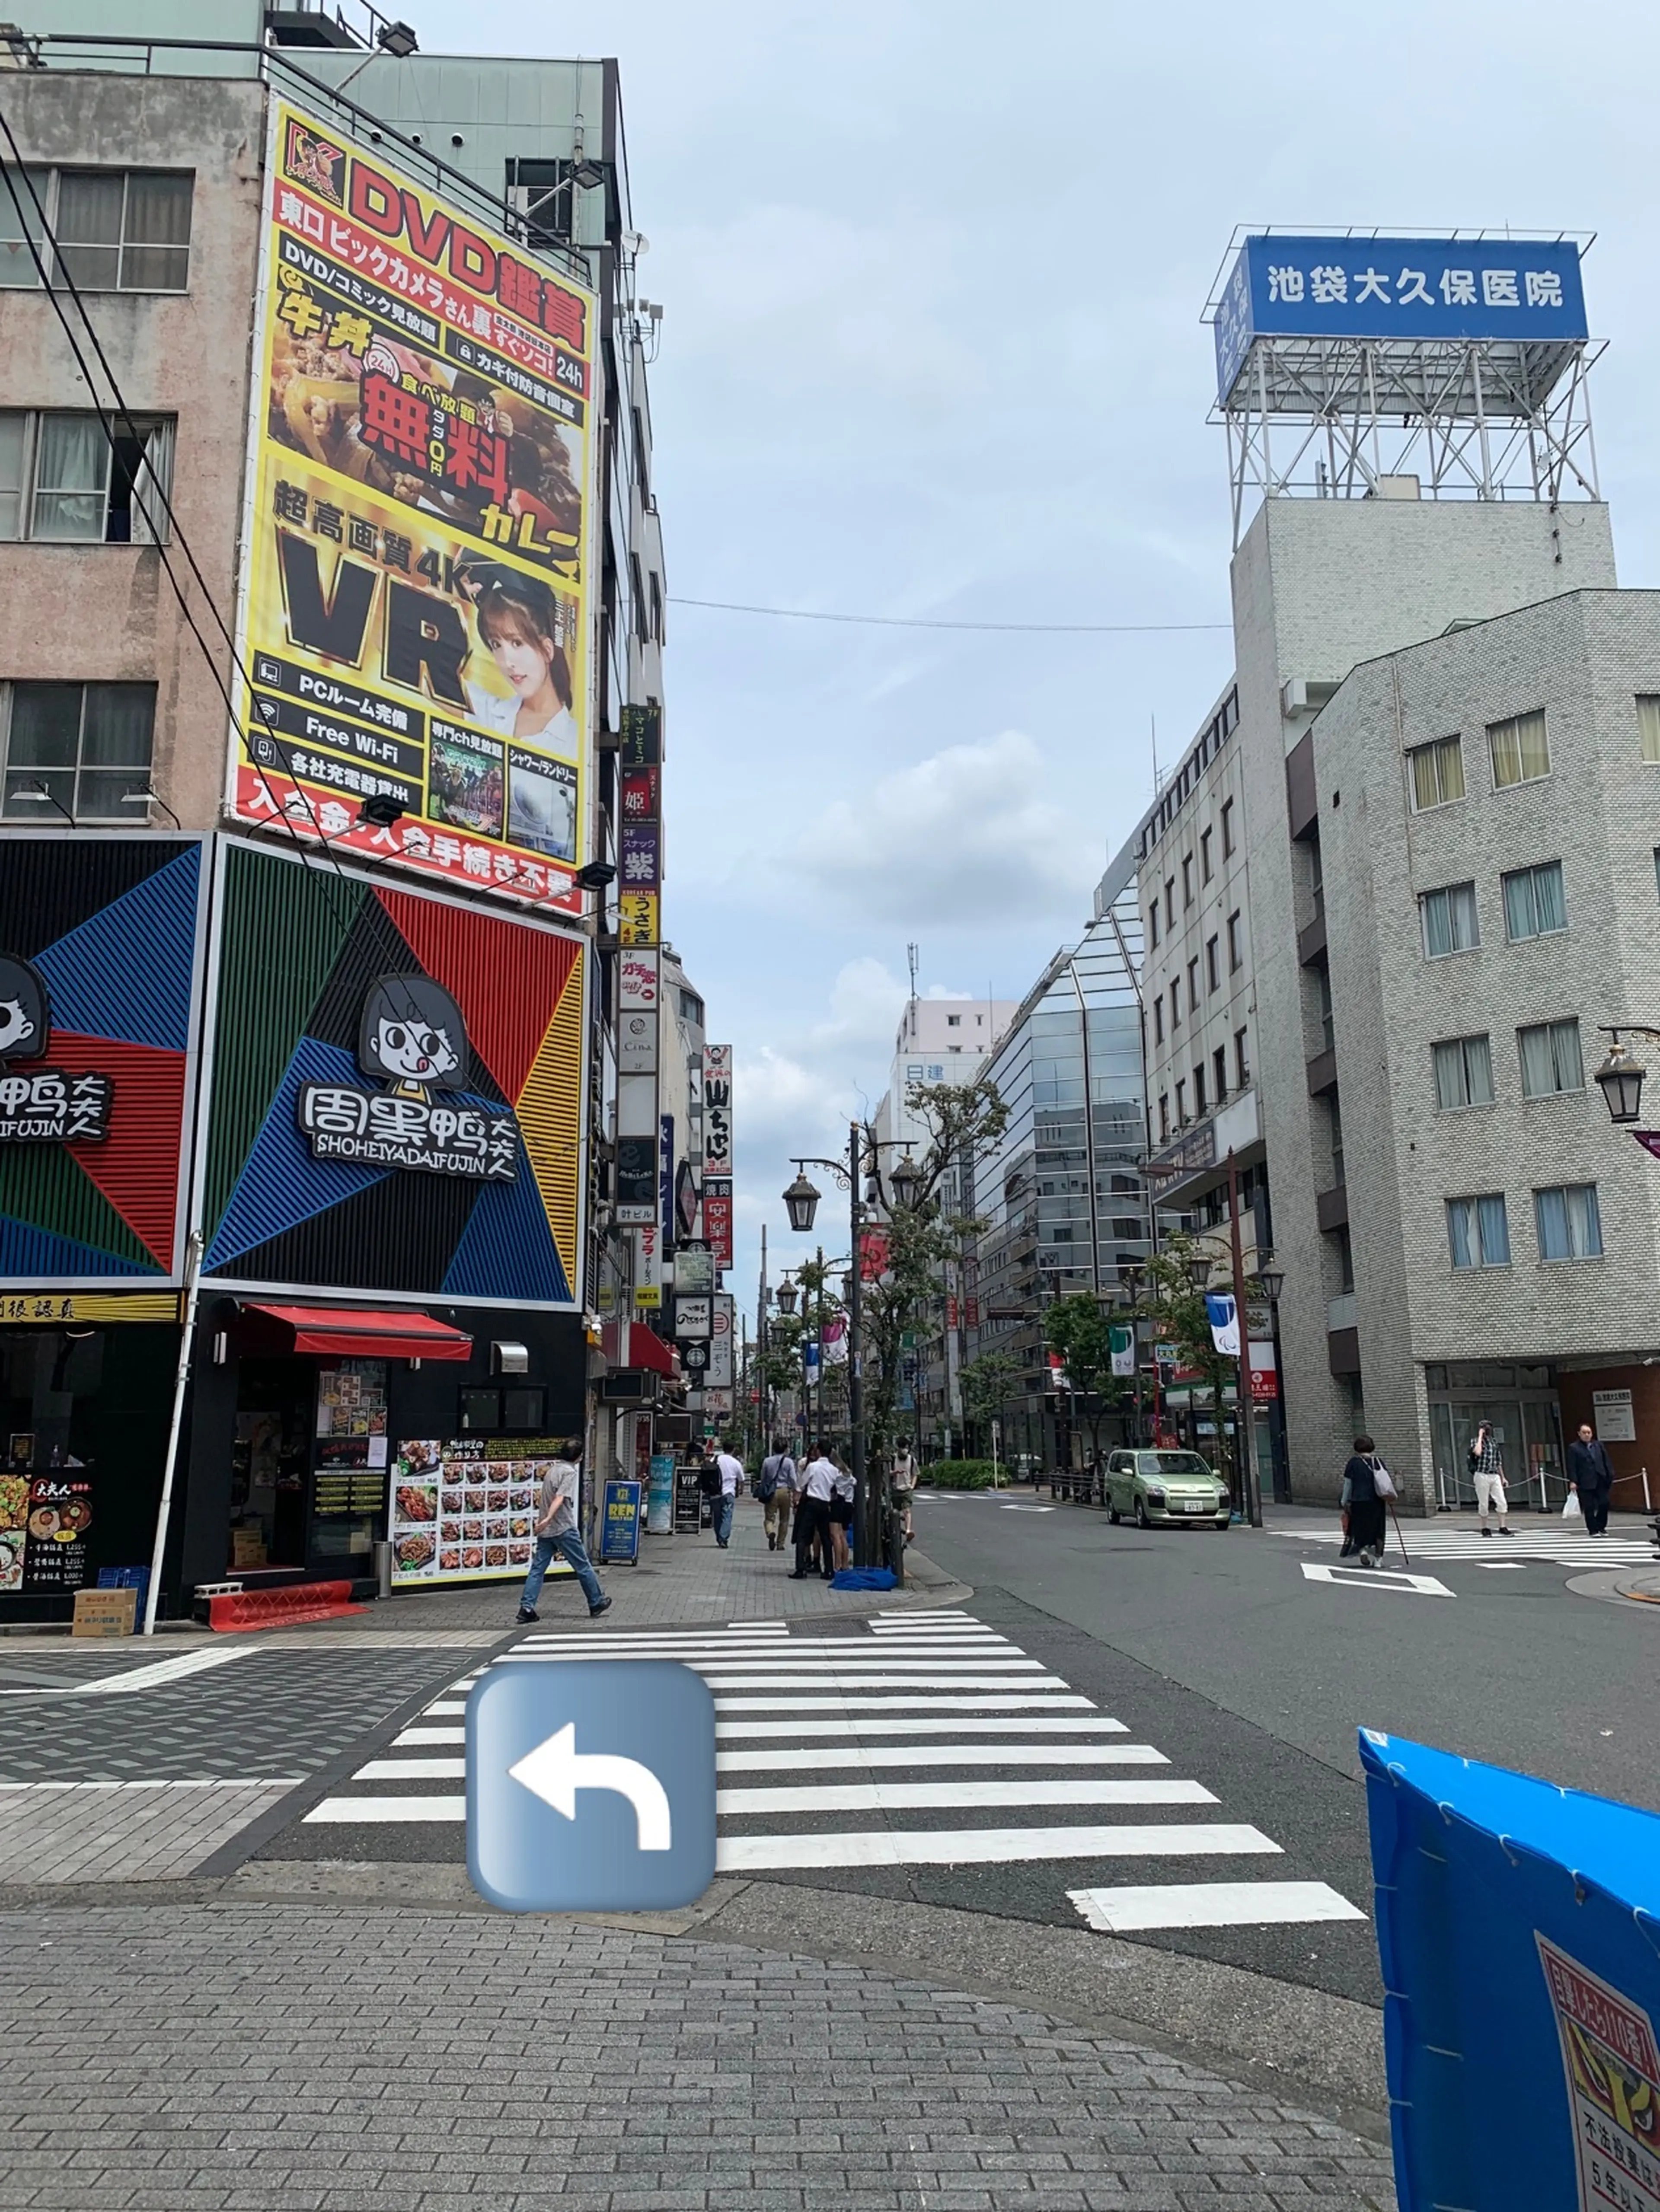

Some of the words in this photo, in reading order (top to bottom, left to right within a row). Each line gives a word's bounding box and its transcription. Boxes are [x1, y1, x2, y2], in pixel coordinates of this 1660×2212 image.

[348, 156, 585, 354] DVD鑑賞
[284, 239, 436, 341] DVD/コミック見放題
[1267, 265, 1563, 307] 池袋大久保医院
[279, 289, 374, 357] 牛丼
[476, 352, 575, 418] カギ付防音個室
[556, 356, 582, 389] 24h
[401, 373, 476, 425] 食べ放題
[362, 374, 508, 506] 無料
[274, 480, 475, 603] 超高画質4K
[480, 503, 578, 554] カレー
[276, 524, 475, 714] VR
[299, 674, 409, 732] PCルーム完備
[306, 713, 350, 746] Free
[354, 733, 399, 764] Wi-Fi
[432, 721, 503, 759] 専門ch見放題
[291, 751, 409, 802] 各社充電器貸出
[510, 749, 577, 781] シャワー/ランドリー
[625, 790, 645, 810] 姫
[623, 829, 636, 837] 5F
[623, 839, 656, 848] スナック
[625, 852, 654, 880] 紫
[634, 897, 653, 943] うさぎ
[907, 1065, 944, 1081] 日建
[706, 1079, 729, 1160] 山ちゃん
[317, 1134, 486, 1174] SHOHEIYADAIFUJIN
[706, 1183, 729, 1196] 焼肉
[621, 1209, 651, 1219] 叶ビル
[0, 1298, 75, 1319] 很認真
[36, 1481, 71, 1496] 大夫人
[681, 1475, 698, 1485] VIP
[608, 1503, 636, 1517] REN
[1551, 1961, 1652, 2075] 目撃したら110番!
